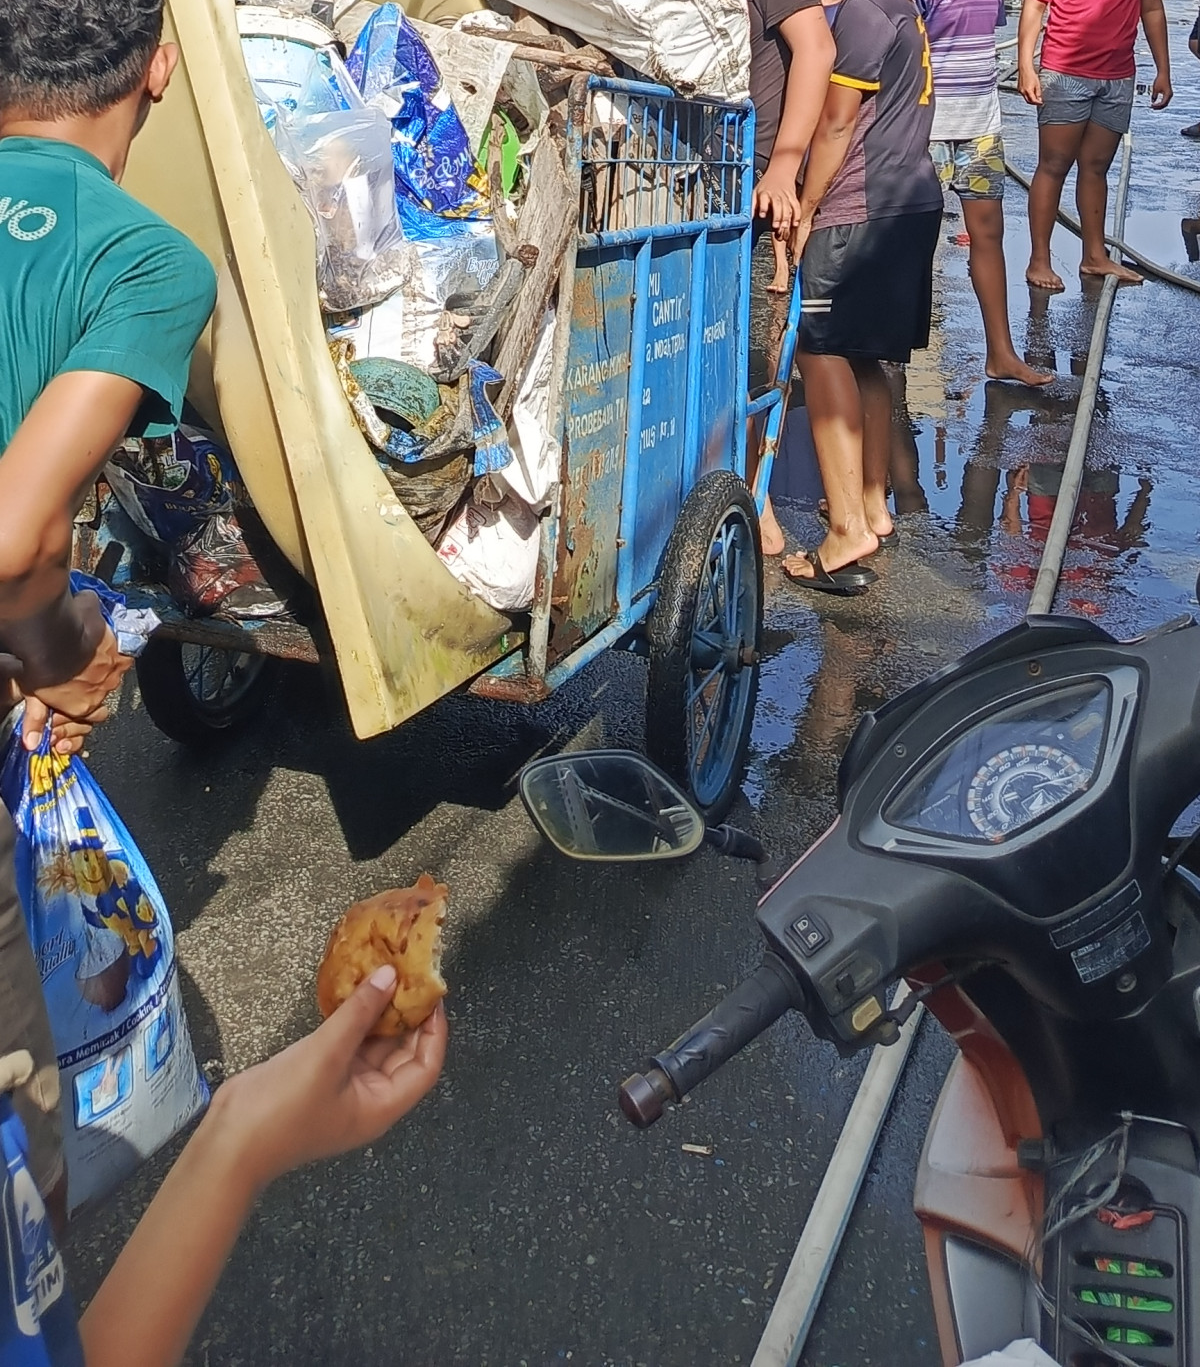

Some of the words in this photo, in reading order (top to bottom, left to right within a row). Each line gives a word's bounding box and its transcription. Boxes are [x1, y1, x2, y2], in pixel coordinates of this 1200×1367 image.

[1016, 756, 1030, 767] 100
[982, 793, 994, 803] 40
[987, 809, 999, 820] 20
